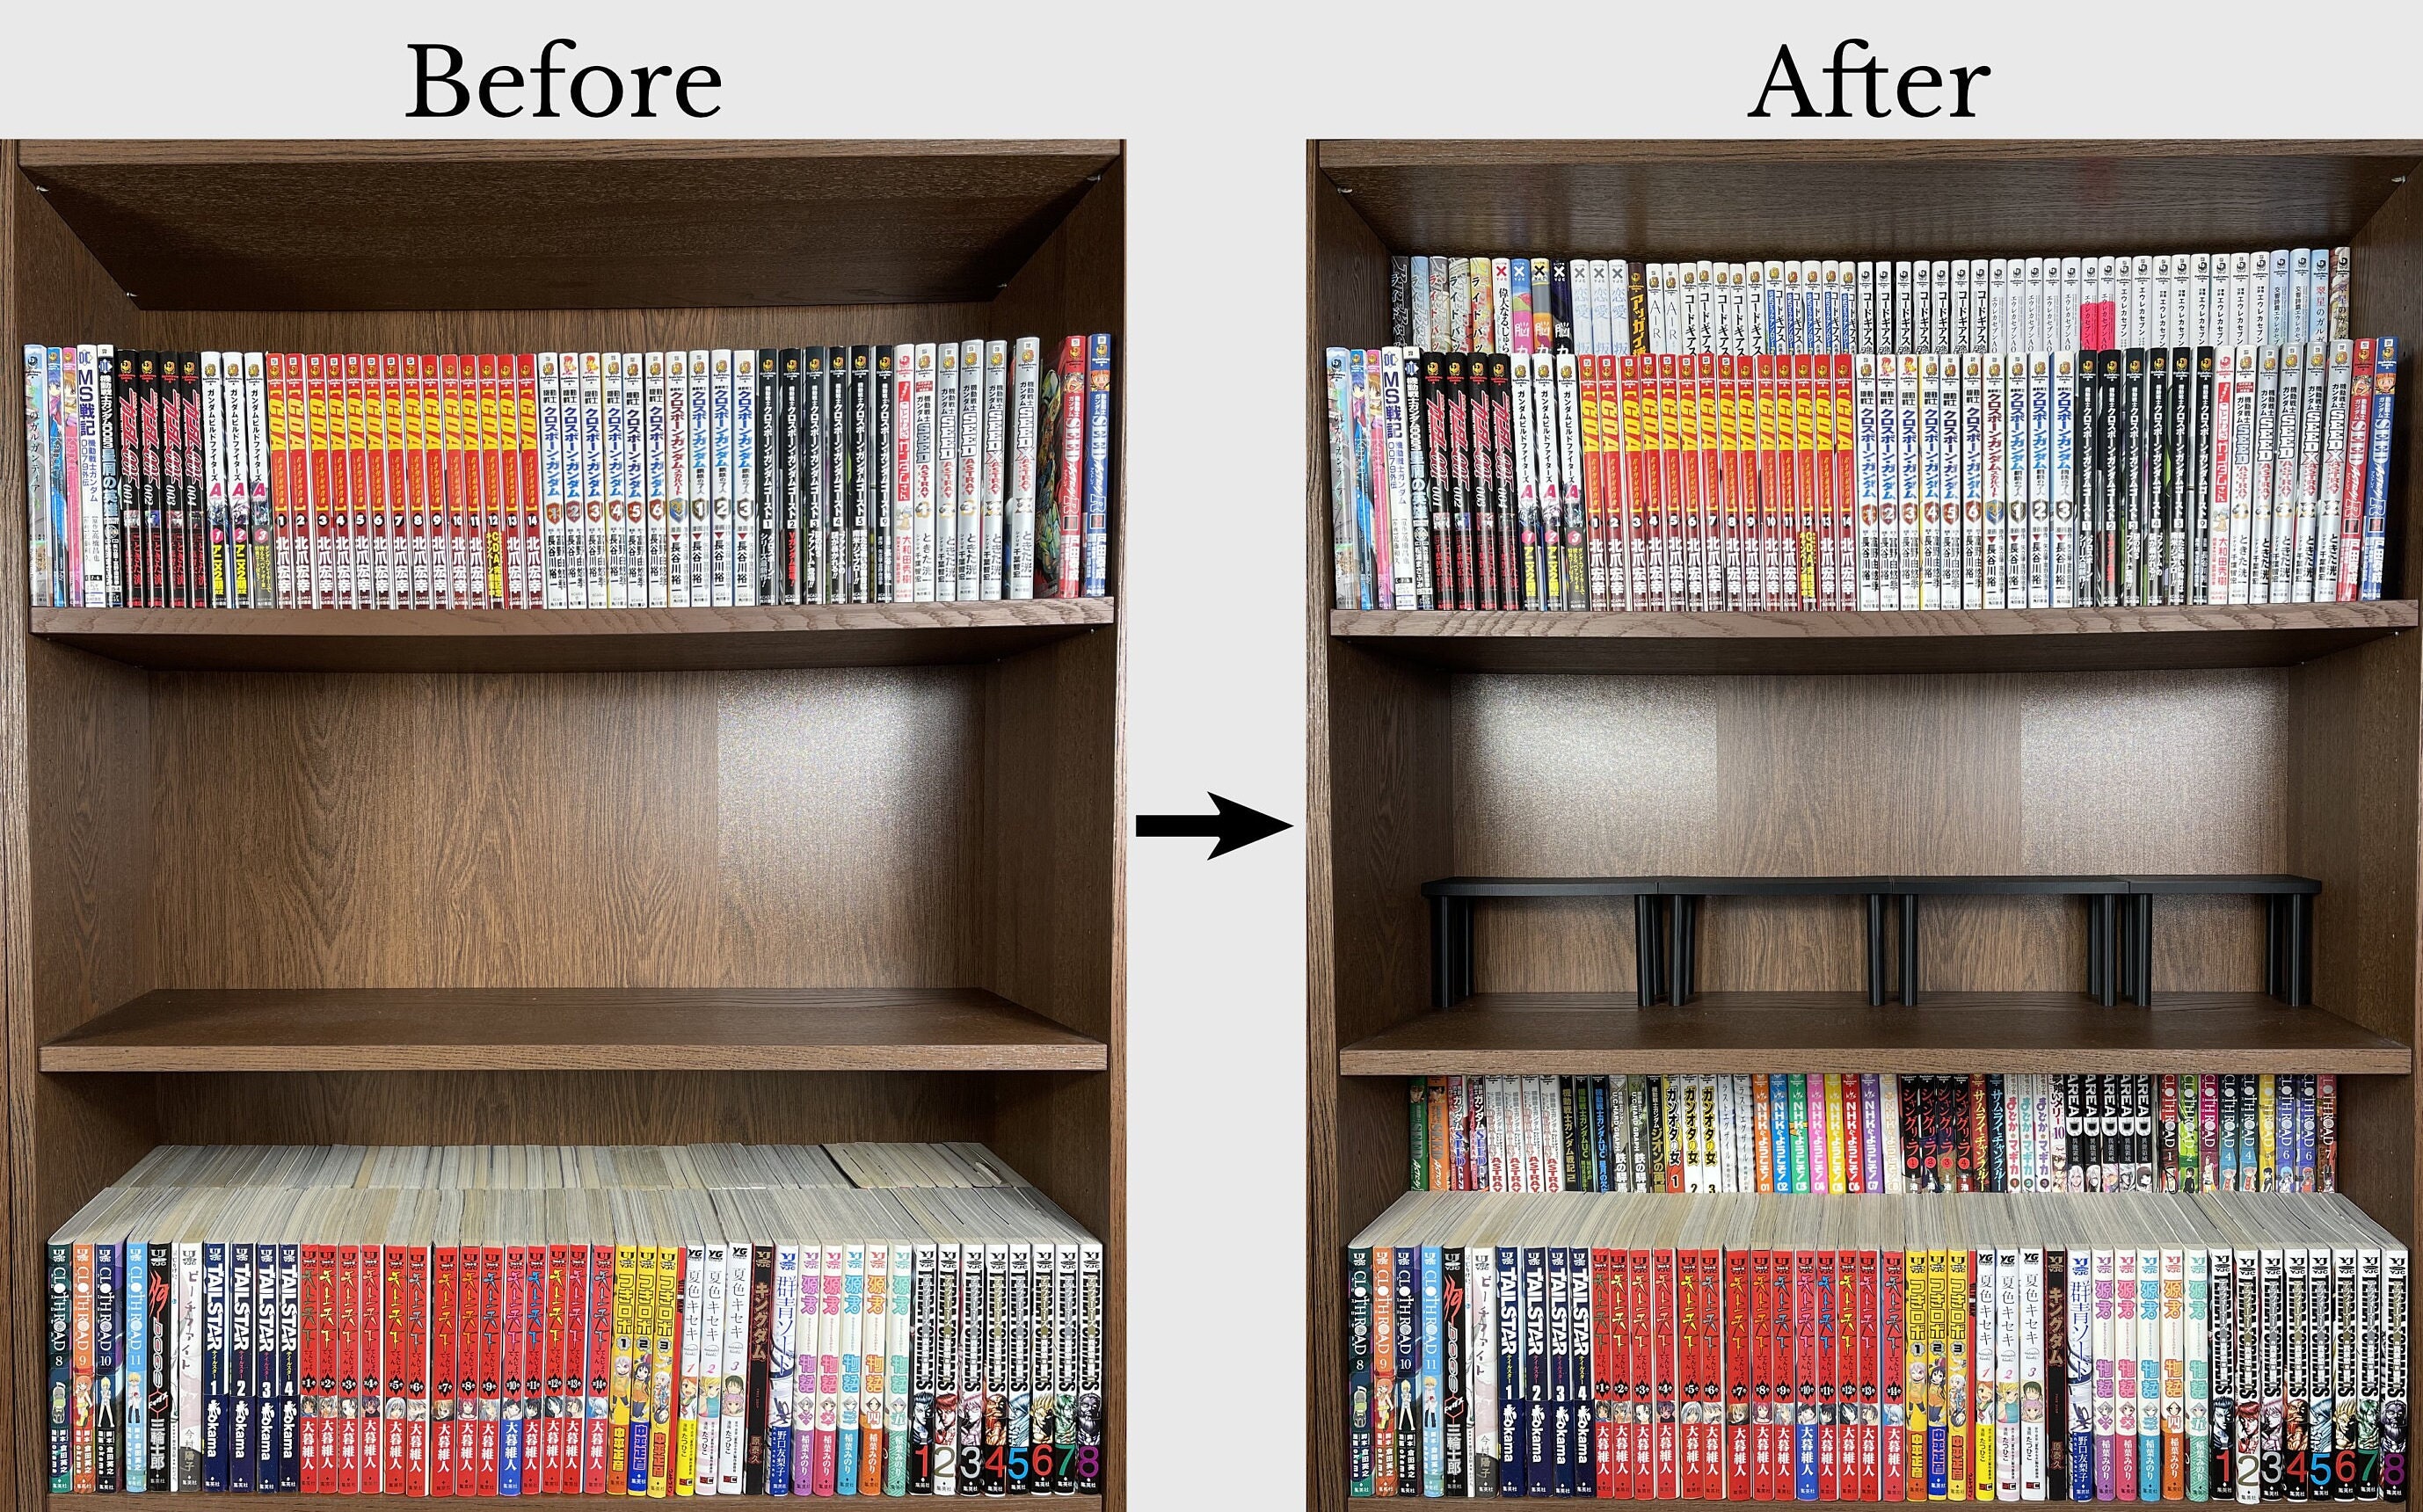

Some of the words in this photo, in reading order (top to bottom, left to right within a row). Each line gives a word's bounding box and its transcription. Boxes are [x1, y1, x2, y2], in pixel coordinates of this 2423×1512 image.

[1650, 300, 1661, 338] AIR
[1666, 302, 1677, 339] AIR
[1776, 291, 1786, 343] コードギアス
[1814, 293, 1823, 343] コードギアス
[1863, 292, 1873, 345] コードギアス
[1902, 292, 1911, 345] コードギアス
[1939, 291, 1948, 345] コードギアス
[1977, 290, 1988, 345] コードギアス
[79, 369, 95, 436] MS戦記
[1385, 372, 1402, 439] MS戦記
[207, 389, 218, 482] ガンダムビルドファイターズ
[230, 389, 242, 482] ガンダムビルドファイターズ
[544, 406, 562, 497] クロスボーン・ガンダム
[584, 408, 601, 497] クロスボーン・ガンダム
[627, 409, 641, 498] クロスボーン・ガンダム
[941, 416, 955, 459] SEED
[962, 413, 977, 456] SEED
[1564, 390, 1575, 483] ガンダムビルドファイターズ
[1880, 408, 1895, 499] クロスボーン・ガンダム
[1967, 408, 1981, 498] クロスボーン・ガンダム
[2259, 417, 2274, 462] SEED
[944, 462, 953, 498] ASTRAY
[2261, 463, 2271, 499] ASTRAY
[296, 516, 303, 525] 2
[336, 515, 345, 525] 4
[374, 515, 382, 525] 6
[414, 515, 422, 525] 8
[453, 515, 462, 525] 10
[488, 515, 498, 525] 12
[528, 515, 537, 525] 14
[590, 505, 599, 518] 3
[611, 505, 621, 518] 4
[653, 504, 661, 517] 6
[697, 504, 703, 517] 1
[717, 504, 726, 517] 2
[1633, 518, 1641, 527] 3
[1670, 516, 1678, 526] 5
[1746, 518, 1755, 527] 9
[1821, 518, 1831, 527] 13
[1888, 506, 1895, 520] 2
[2063, 505, 2071, 518] 3
[214, 531, 221, 541] 1
[237, 530, 244, 541] 2
[258, 530, 266, 541] 3
[276, 537, 291, 592] 北爪宏幸
[317, 536, 332, 592] 北爪宏幸
[395, 537, 409, 592] 北爪宏幸
[452, 537, 466, 592] 北爪宏幸
[507, 537, 522, 592] 北爪宏幸
[548, 534, 557, 585] 長谷川裕一
[671, 542, 681, 592] 長谷川裕一
[715, 541, 724, 586] 長谷川裕一
[903, 536, 912, 584] 大和田秀樹
[1609, 539, 1621, 594] 北爪宏幸
[1687, 539, 1700, 594] 北爪宏幸
[1783, 539, 1796, 594] 北爪宏幸
[1987, 545, 1997, 593] 長谷川裕一
[1667, 1087, 1682, 1167] ガンオタの女
[1684, 1087, 1699, 1167] ガンオタの女
[1702, 1087, 1716, 1167] ガンオタの女
[1739, 1087, 1748, 1162] ラストエグザイル
[1903, 1089, 1919, 1156] シャングリ・ラ
[1956, 1088, 1971, 1156] シャングリ・ラ
[2054, 1126, 2064, 1139] 10
[1491, 1158, 1502, 1192] ASTRAY
[1529, 1156, 1539, 1191] ASTRAY
[2009, 1140, 2019, 1175] マギカ
[2167, 1152, 2172, 1161] 1
[2187, 1152, 2193, 1161] 2
[2225, 1152, 2231, 1161] 4
[2283, 1150, 2289, 1159] 6
[2325, 1149, 2331, 1159] 7
[1672, 1176, 1678, 1188] 1
[617, 1274, 635, 1334] つきロボ
[707, 1269, 721, 1342] 夏色キセキ
[751, 1282, 769, 1362] キングダム
[1930, 1278, 1946, 1340] つきロボ
[2025, 1274, 2039, 1345] 夏色キセキ
[2048, 1287, 2063, 1366] キングダム
[2070, 1280, 2091, 1381] 群青ソード
[55, 1356, 62, 1365] 8
[100, 1356, 111, 1365] 10
[707, 1364, 716, 1374] 2
[1380, 1359, 1387, 1369] 9
[237, 1381, 245, 1396] 2
[149, 1419, 164, 1470] 三輪士郎
[342, 1421, 356, 1470] 大暮維人
[389, 1421, 402, 1471] 大暮維人
[505, 1421, 518, 1471] 大暮維人
[775, 1431, 785, 1477] 野口友梨子
[844, 1434, 853, 1474] 稲葉みのり
[915, 1452, 927, 1477] 1
[961, 1447, 980, 1479] 3
[1008, 1448, 1028, 1479] 5
[1077, 1446, 1099, 1478] 8
[1481, 1436, 1491, 1477] 今村陽子
[1616, 1427, 1628, 1475] 大暮維人
[1821, 1428, 1834, 1477] 大暮維人
[2123, 1437, 2132, 1480] 稲葉みのり
[2335, 1450, 2355, 1482] 6
[2360, 1450, 2378, 1481] 7
[2237, 1455, 2259, 1486] 2
[2287, 1453, 2308, 1482] 4
